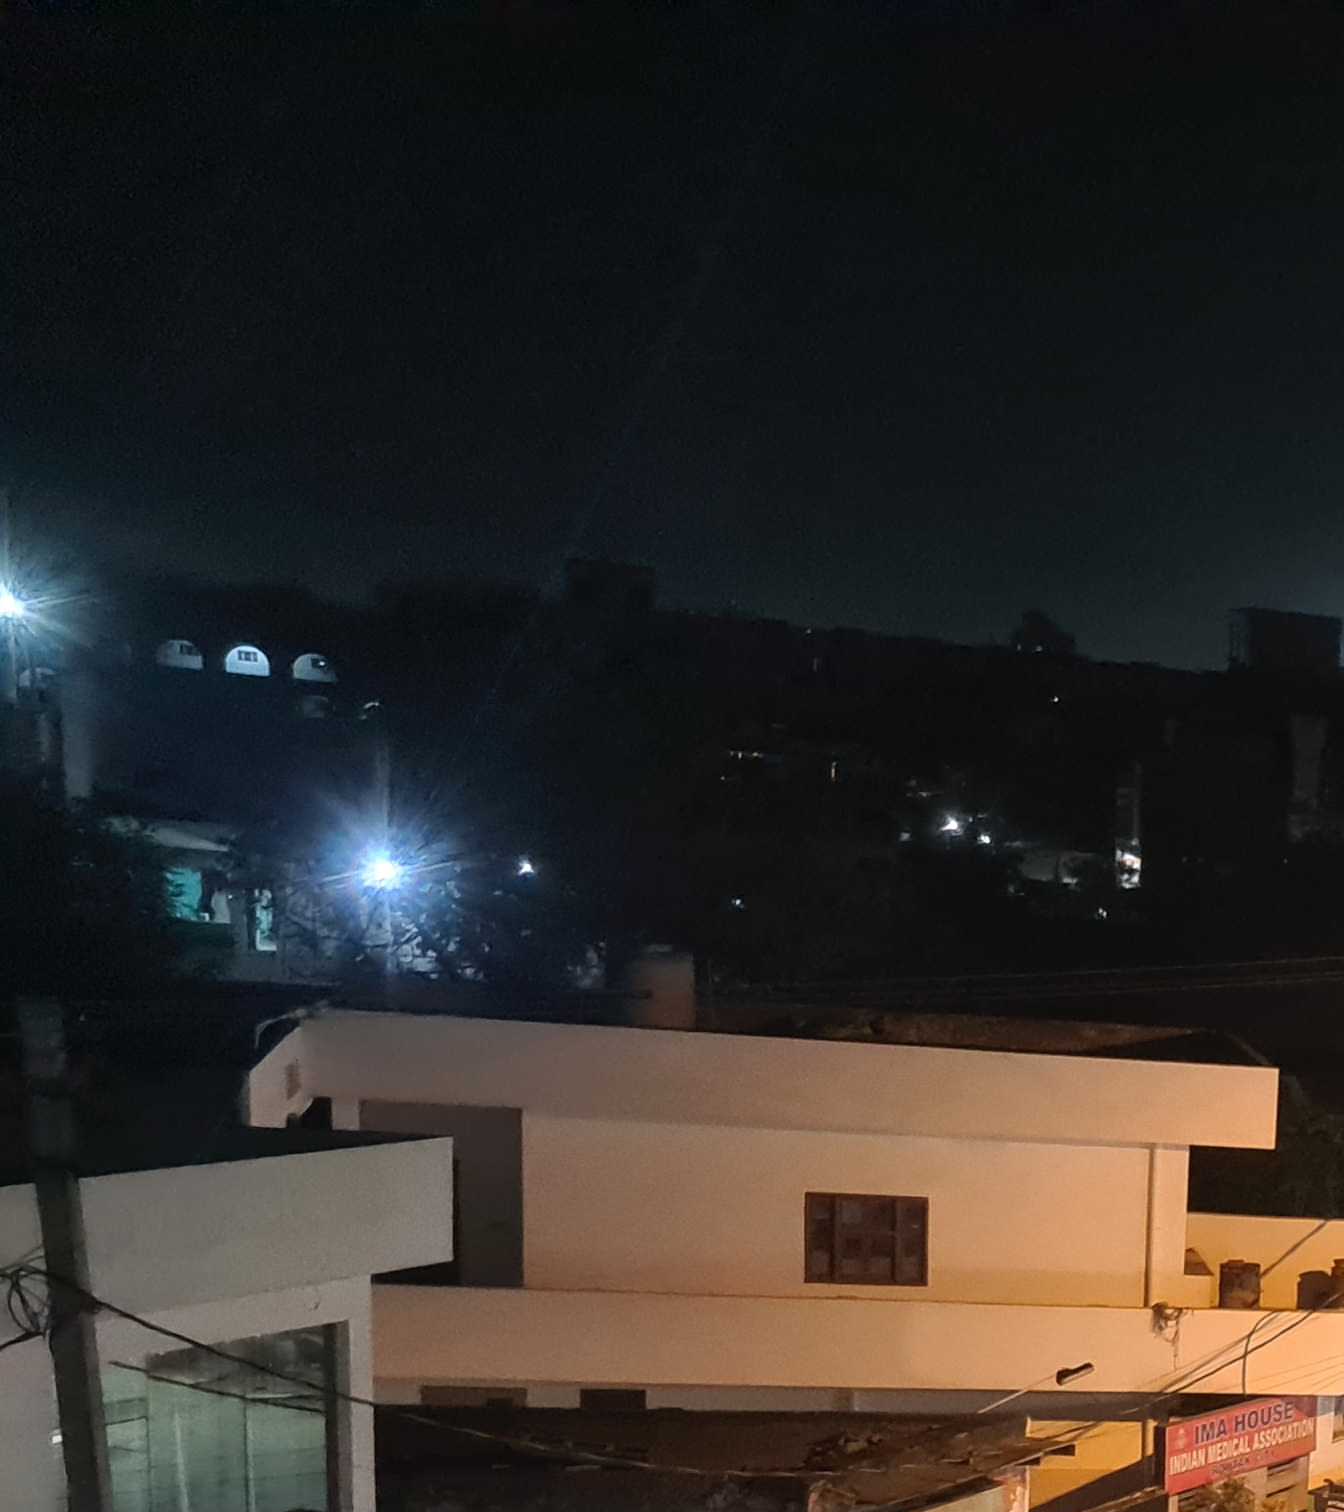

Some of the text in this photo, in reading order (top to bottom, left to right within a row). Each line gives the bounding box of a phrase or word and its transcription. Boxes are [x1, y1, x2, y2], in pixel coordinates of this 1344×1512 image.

[1169, 1447, 1206, 1475] INDIAN
[1207, 1436, 1250, 1463] MEDICAL
[1252, 1418, 1315, 1451] ASSOCIATION
[1194, 1401, 1296, 1444] IMA HOUSE
